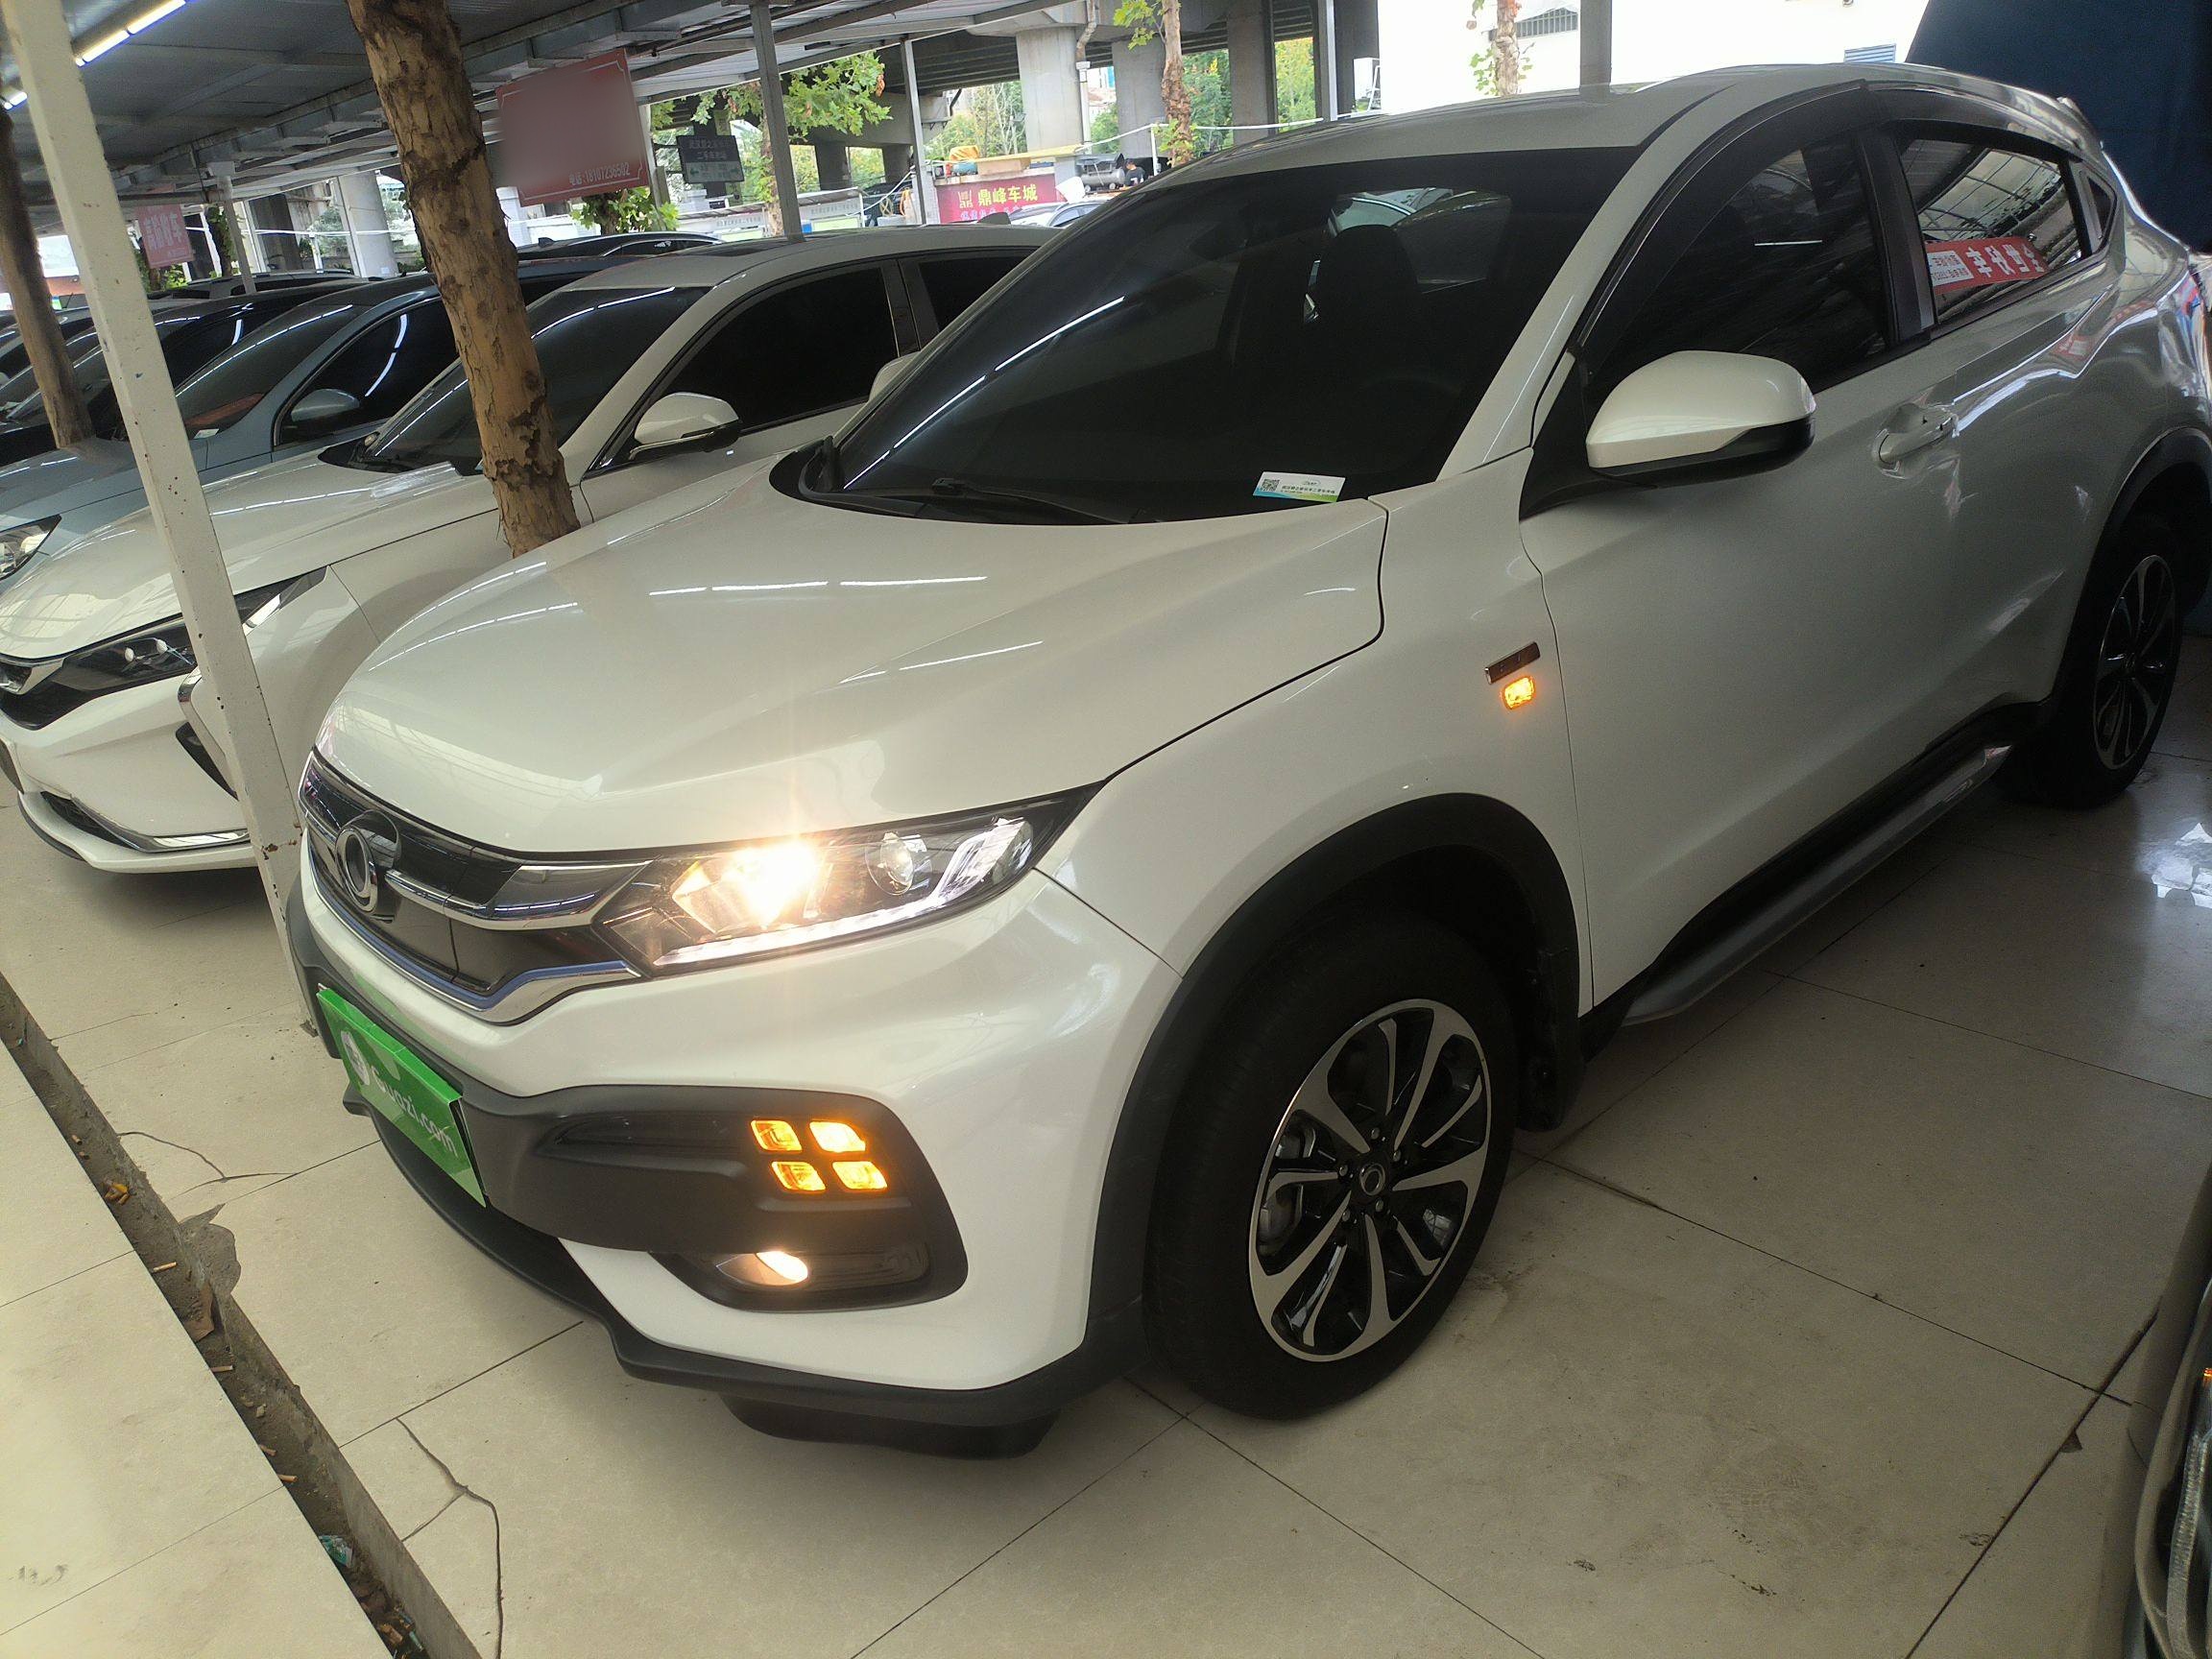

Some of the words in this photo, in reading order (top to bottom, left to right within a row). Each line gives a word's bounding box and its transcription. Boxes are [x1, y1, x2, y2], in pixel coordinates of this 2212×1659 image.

[977, 183, 1038, 207] 鼎峰车城
[371, 1065, 459, 1158] Guazi.com
